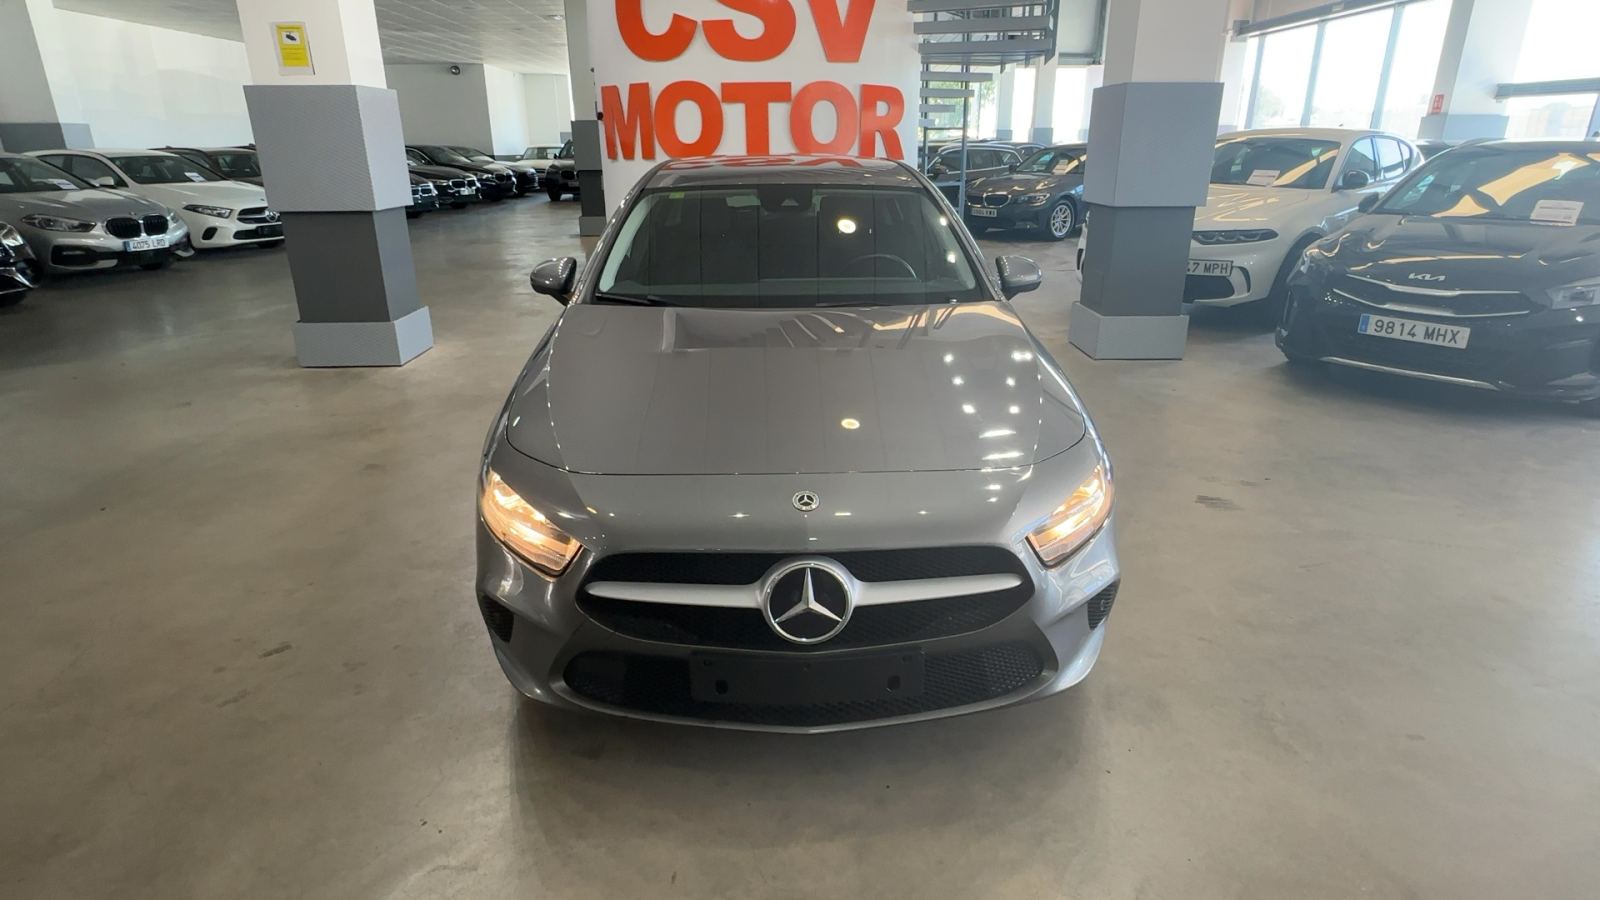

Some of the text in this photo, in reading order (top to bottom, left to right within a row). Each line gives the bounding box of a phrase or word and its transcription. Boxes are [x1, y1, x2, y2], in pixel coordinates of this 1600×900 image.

[615, 0, 876, 63] CSV
[601, 80, 905, 160] MOTOR
[1203, 262, 1229, 274] MPH
[1374, 319, 1460, 345] 9814 MHX
